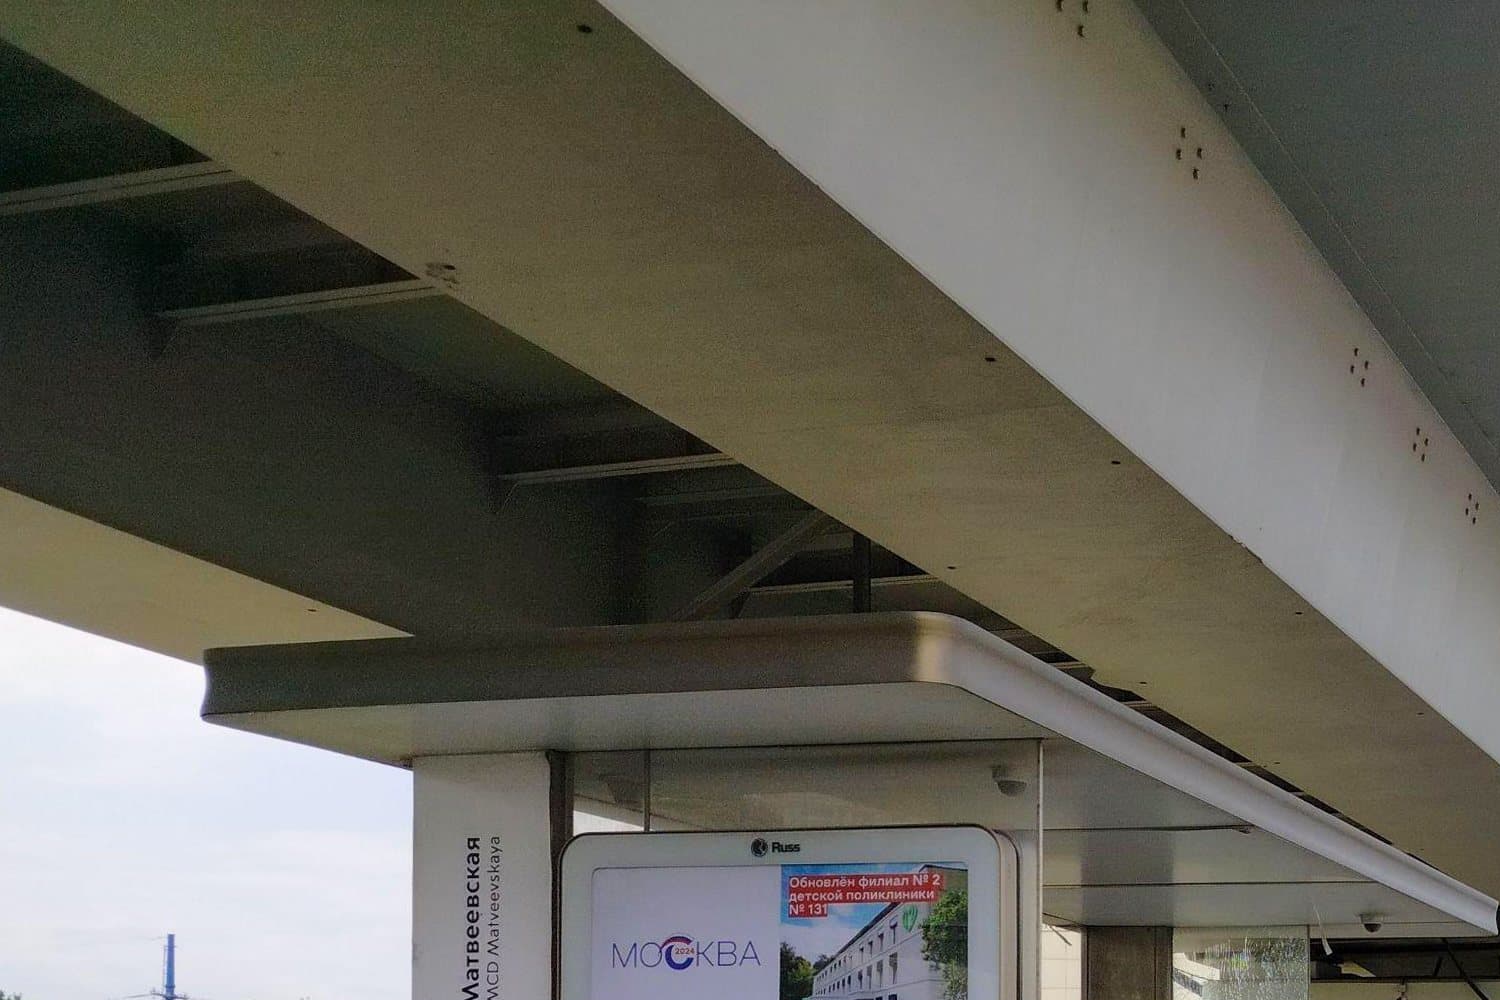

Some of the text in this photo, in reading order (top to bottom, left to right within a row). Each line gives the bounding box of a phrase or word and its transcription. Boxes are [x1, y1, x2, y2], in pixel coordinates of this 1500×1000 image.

[771, 842, 801, 853] Russ
[789, 874, 941, 891] Обновлён филиал № 2
[486, 836, 504, 957] Matveevskaya
[789, 889, 935, 903] детской поликлиники
[789, 904, 828, 915] № 131
[612, 935, 761, 970] МОСКВА
[674, 947, 695, 955] 2024
